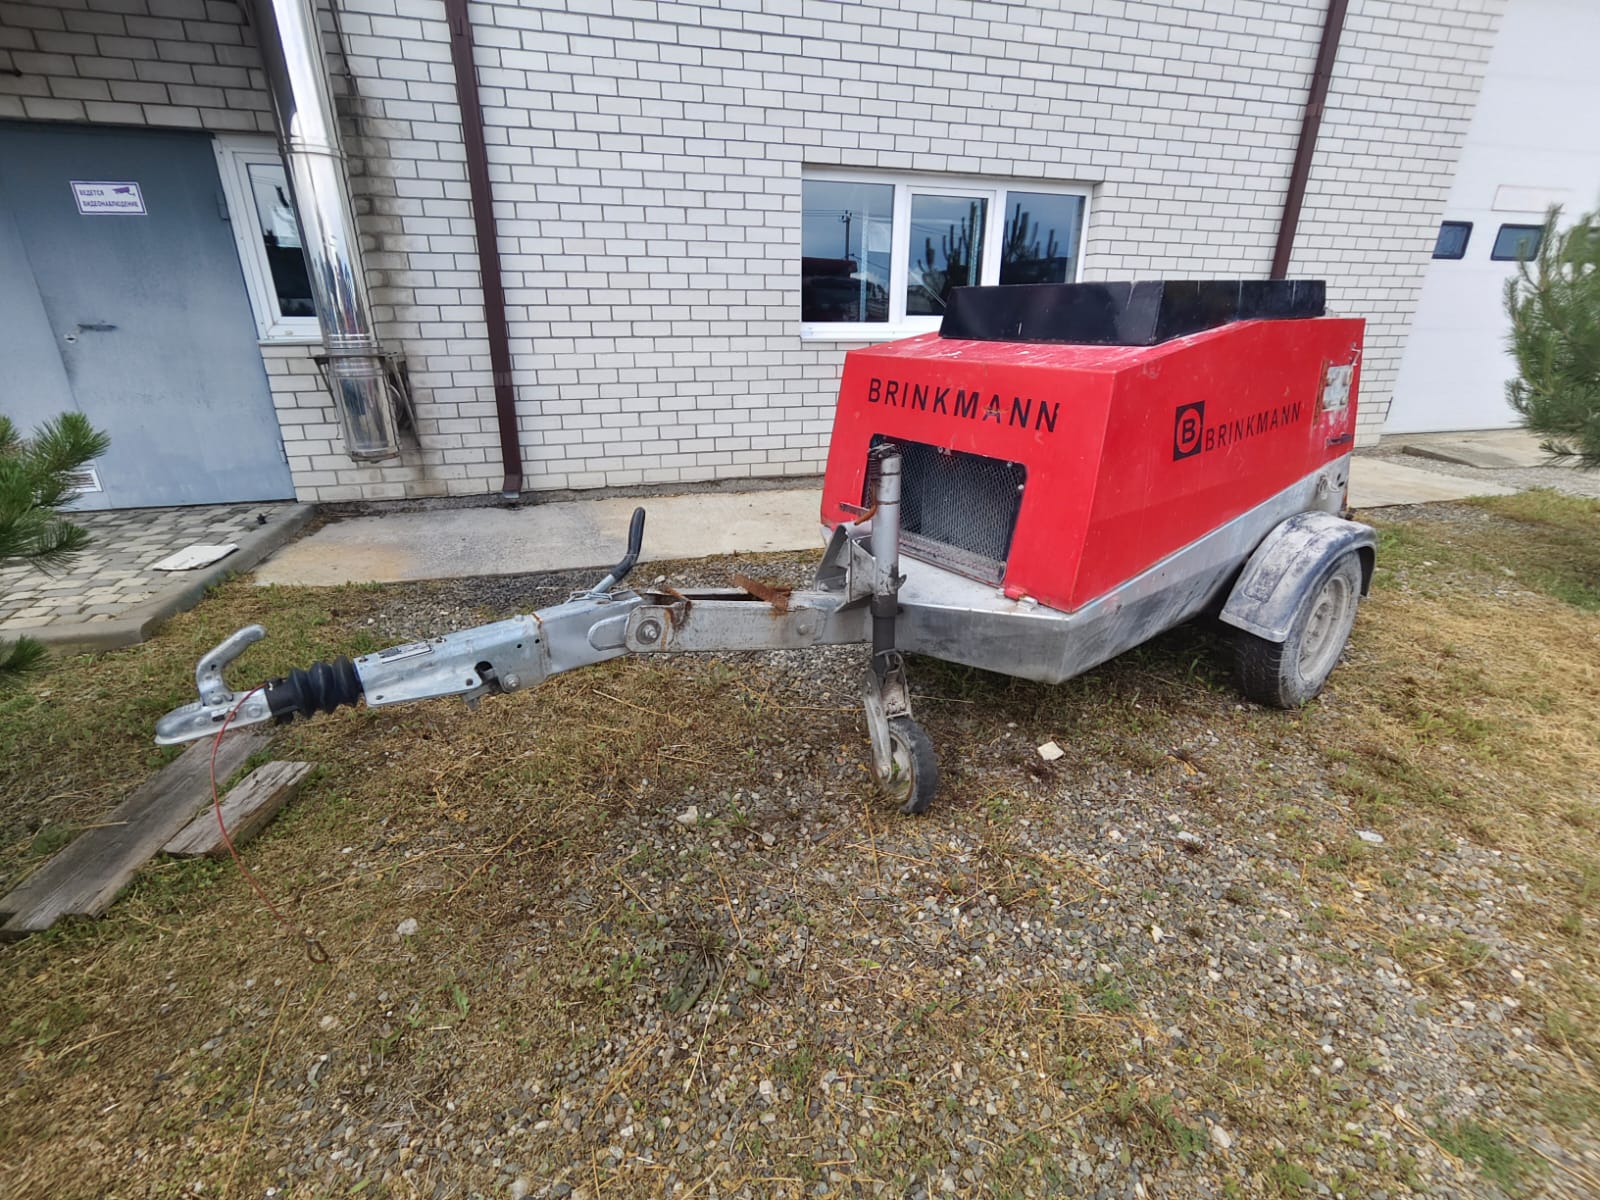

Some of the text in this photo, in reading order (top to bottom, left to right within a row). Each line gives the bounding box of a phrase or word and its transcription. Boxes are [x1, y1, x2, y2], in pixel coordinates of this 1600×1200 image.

[868, 377, 1061, 433] BRINKMANN
[1205, 401, 1302, 452] BRINKMANN
[1181, 418, 1197, 445] B
